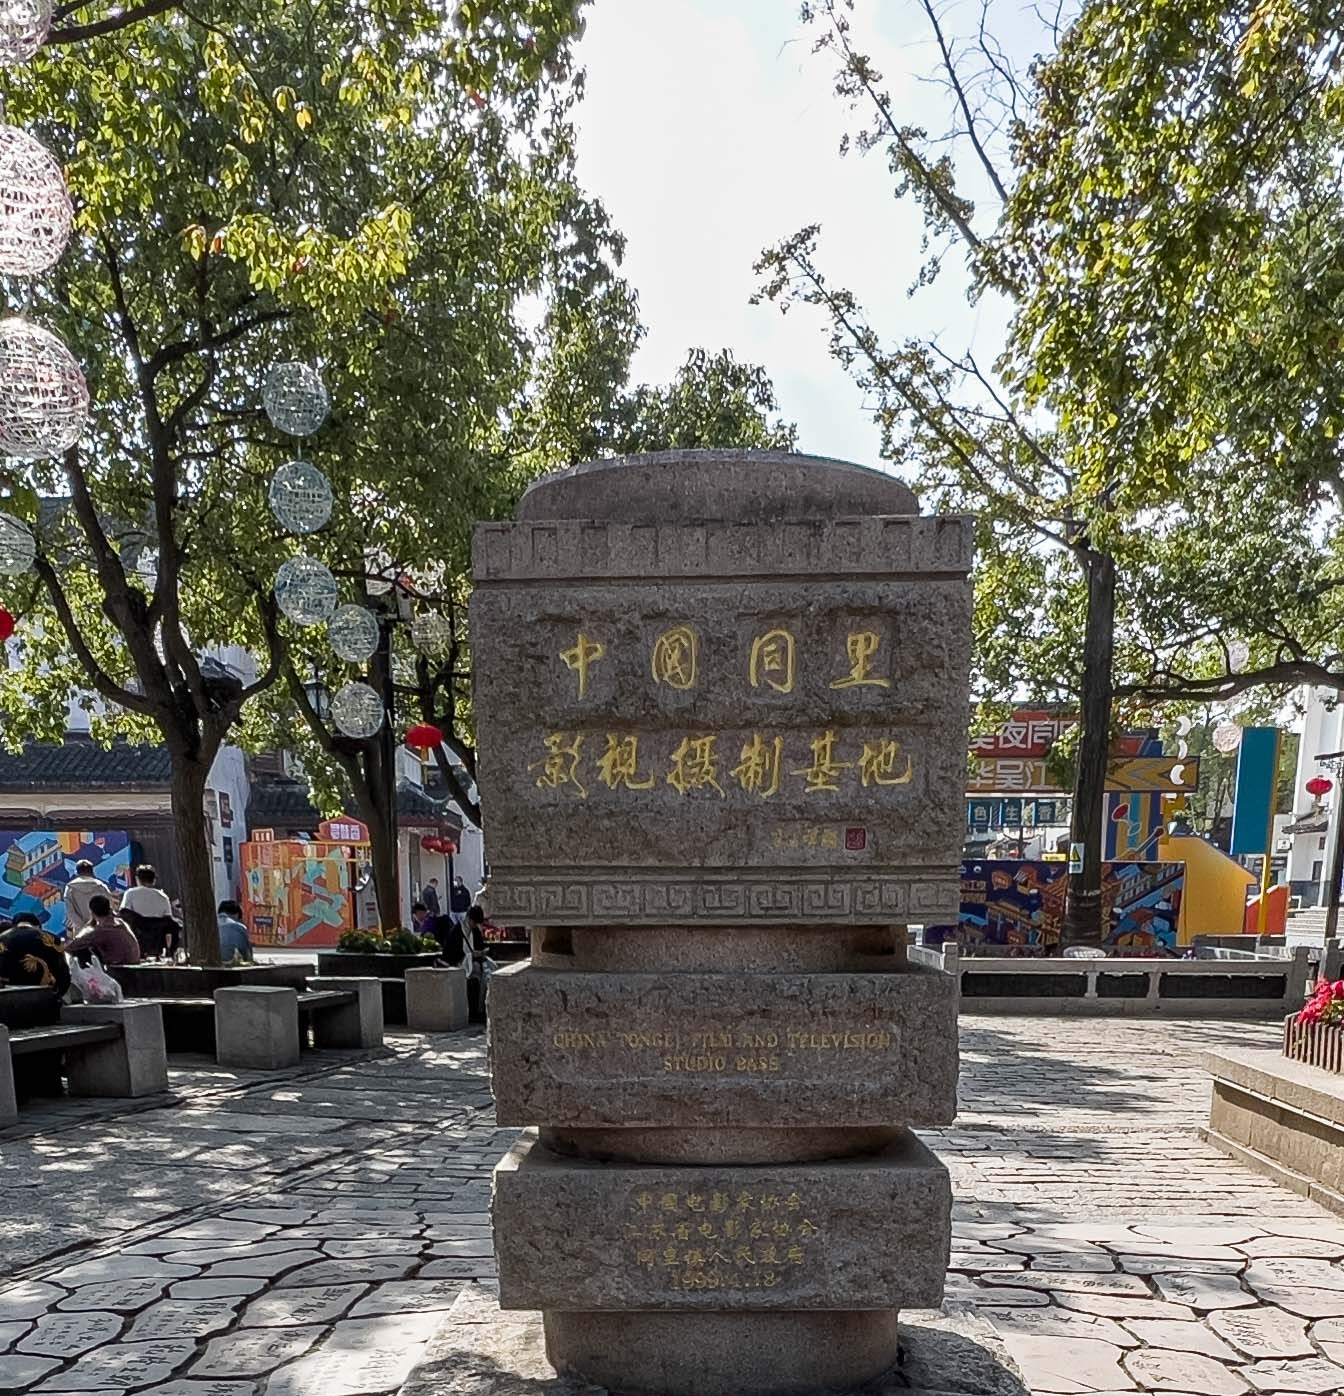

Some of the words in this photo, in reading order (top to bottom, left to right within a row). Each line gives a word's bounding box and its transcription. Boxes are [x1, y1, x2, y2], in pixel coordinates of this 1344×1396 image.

[528, 728, 913, 799] 影视摄制基地
[663, 1056, 726, 1071] STUDIO
[736, 1056, 780, 1071] BASE
